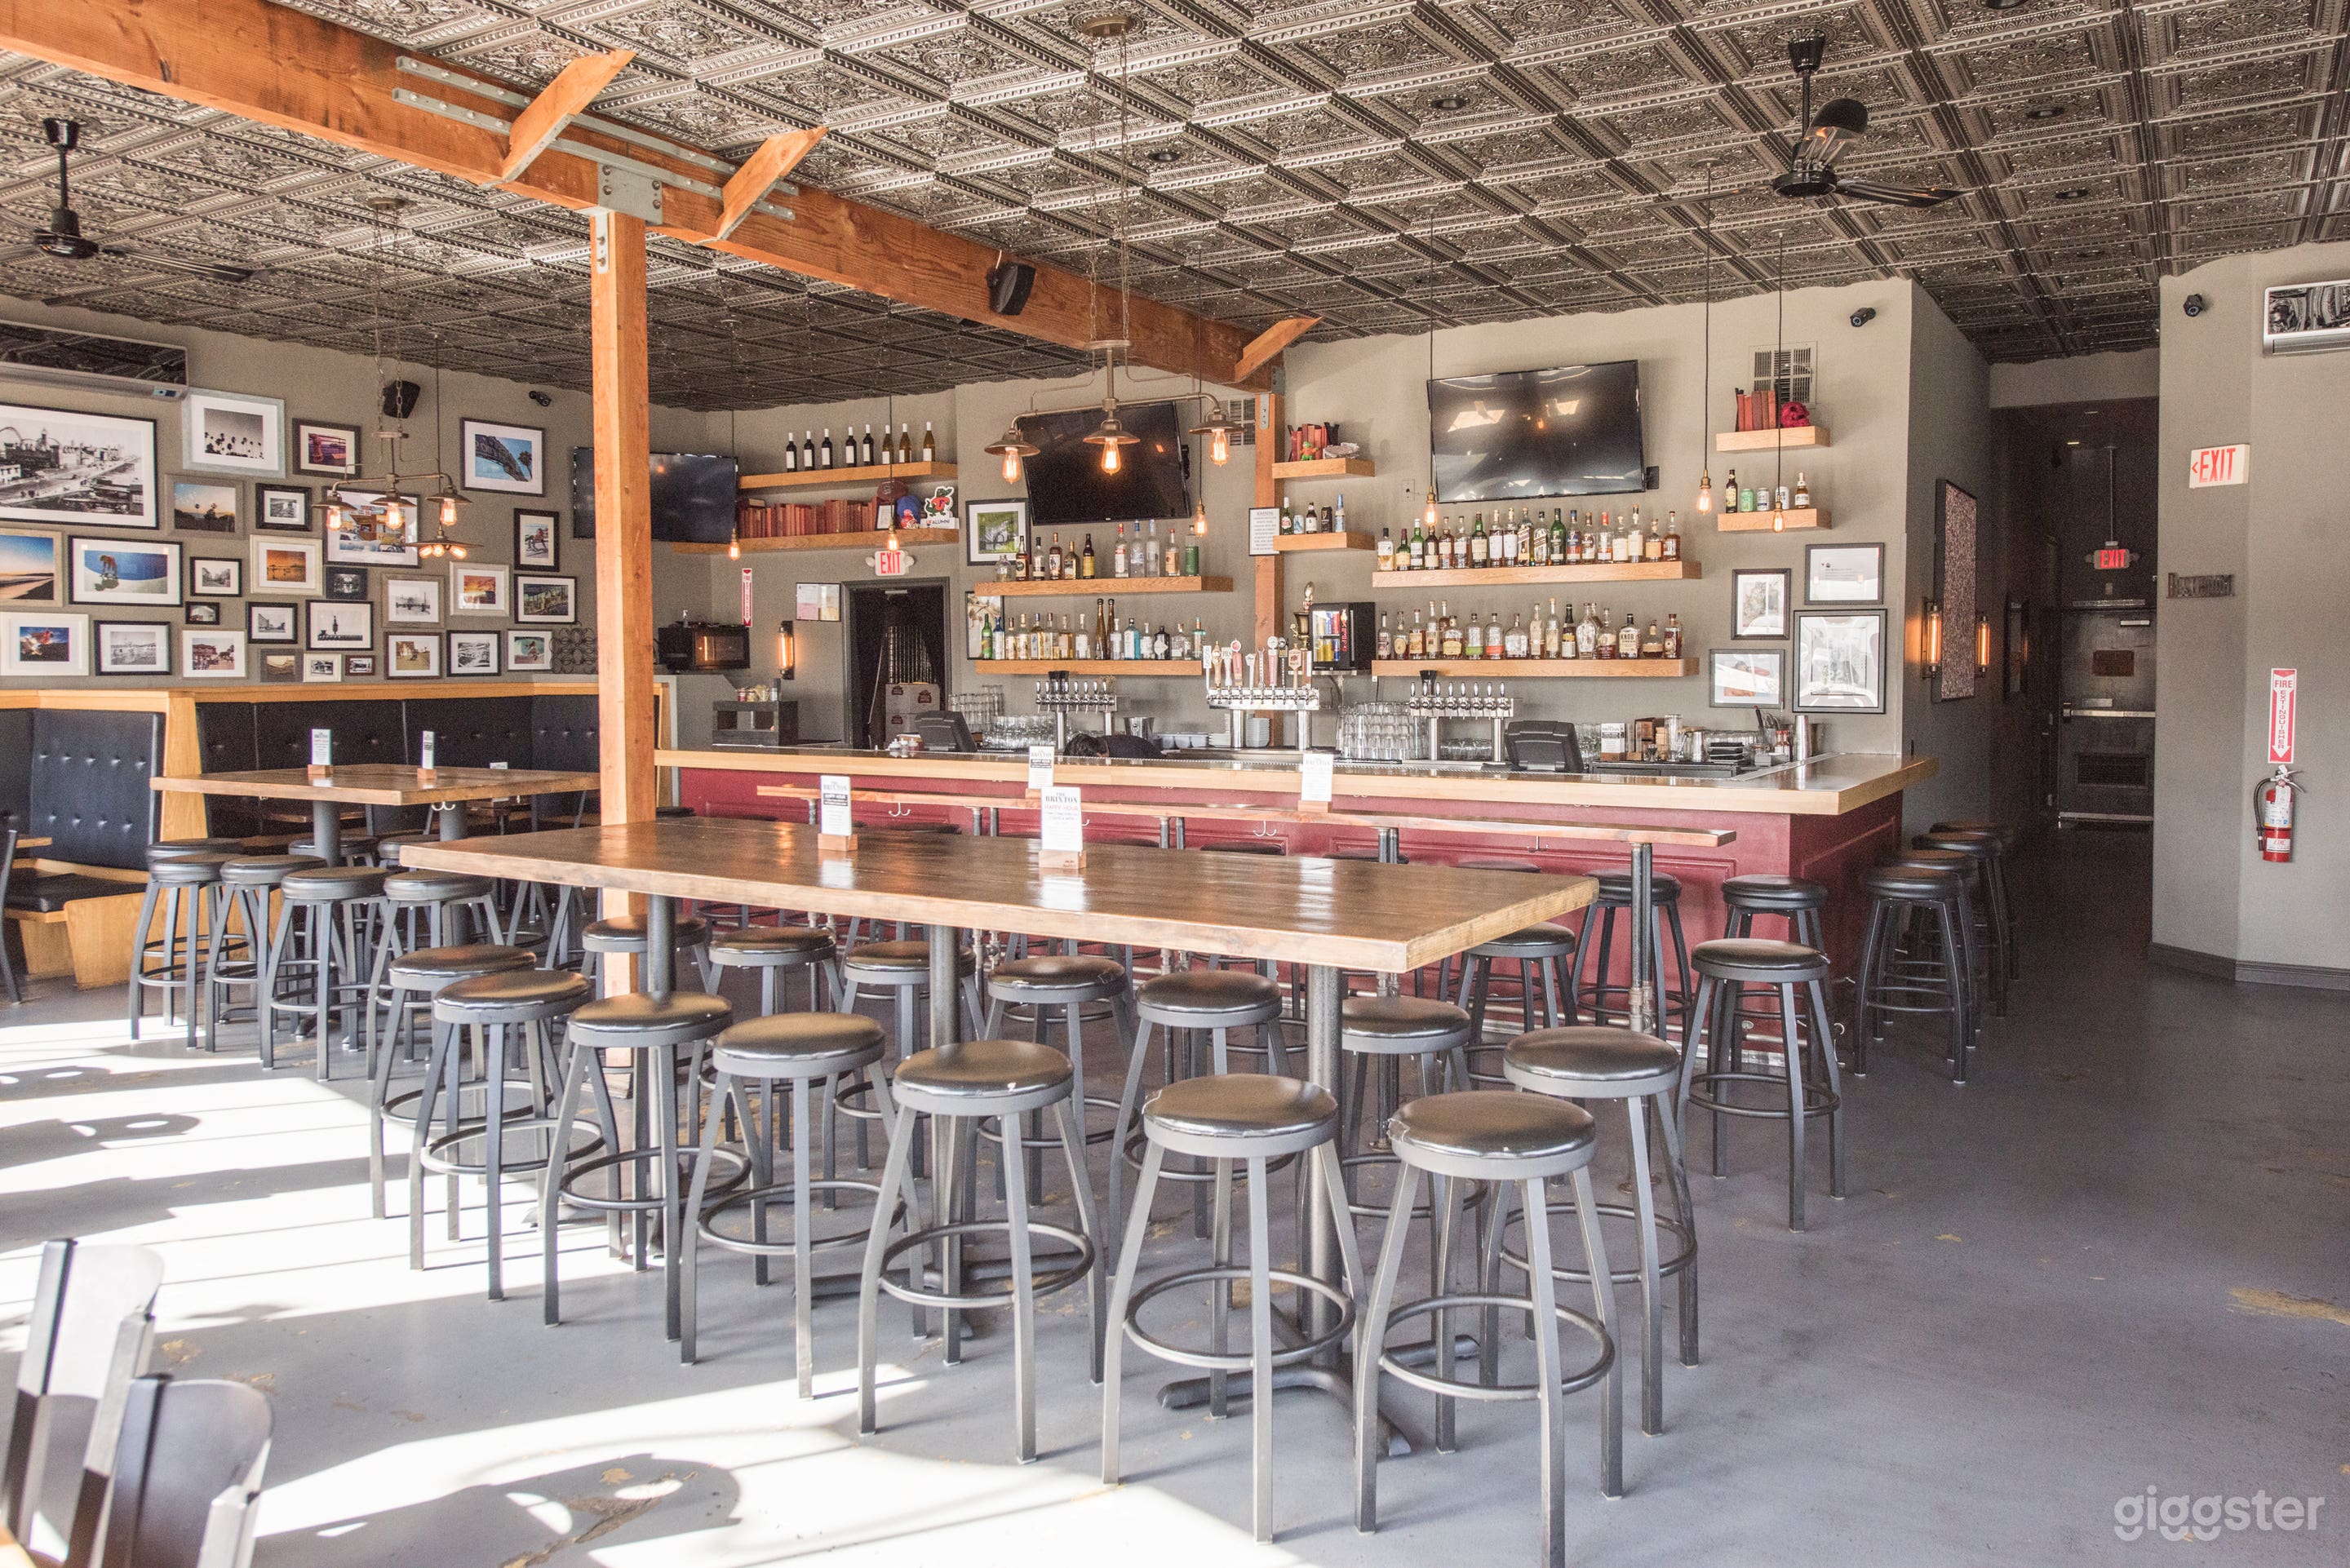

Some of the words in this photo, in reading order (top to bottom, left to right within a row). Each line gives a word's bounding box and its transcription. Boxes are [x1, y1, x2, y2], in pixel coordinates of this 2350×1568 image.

[2198, 448, 2236, 484] EXIT
[880, 551, 901, 574] EXIT
[2099, 548, 2126, 569] EXIT
[2274, 680, 2293, 689] FIRE
[2277, 689, 2286, 749] EXTINGUISHER
[1044, 795, 1078, 804] BRIXTON
